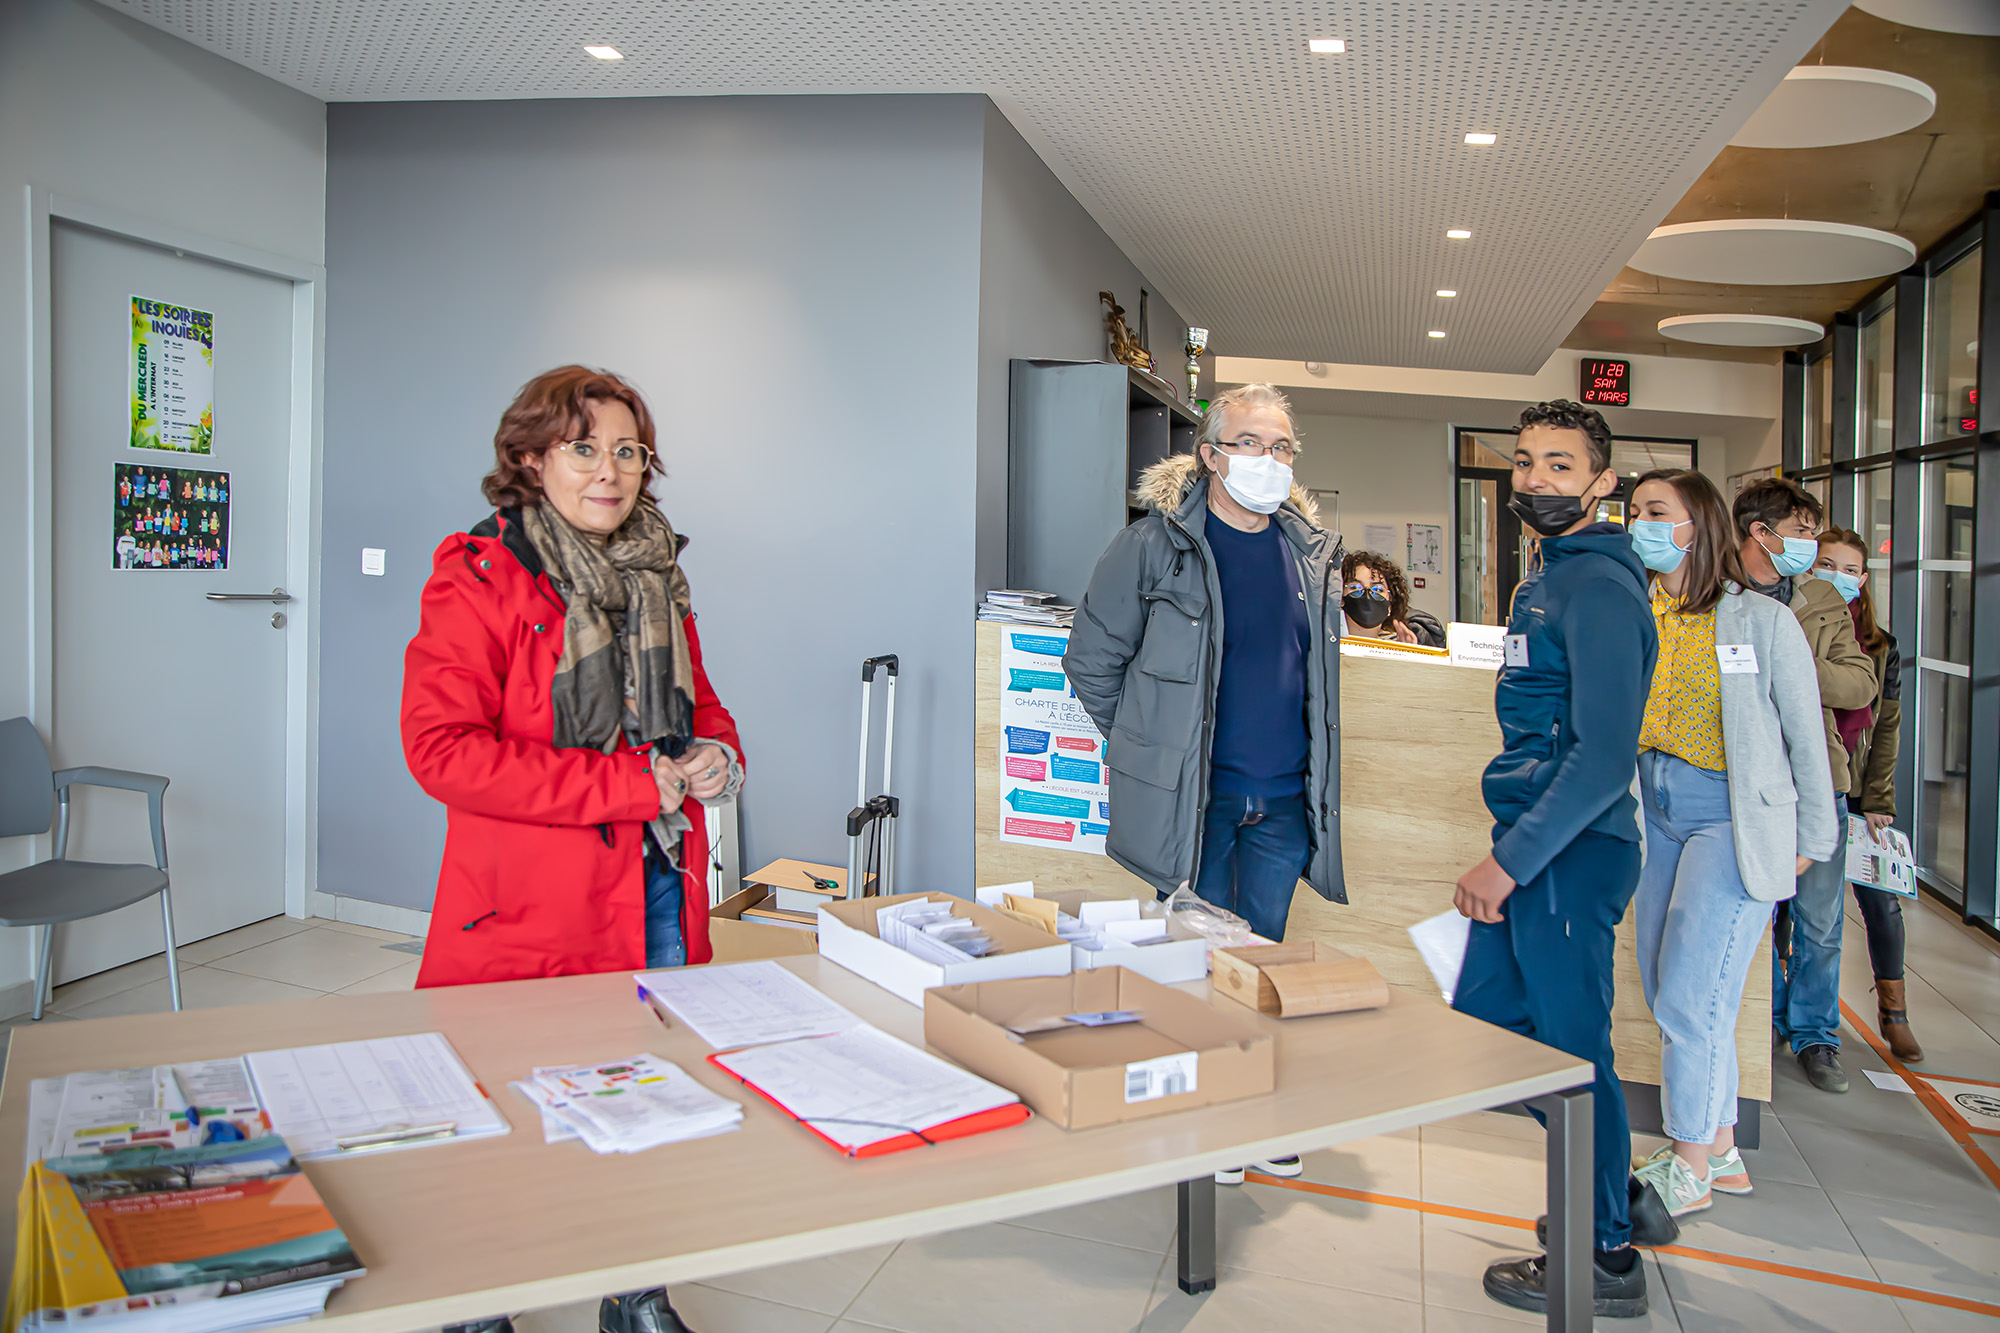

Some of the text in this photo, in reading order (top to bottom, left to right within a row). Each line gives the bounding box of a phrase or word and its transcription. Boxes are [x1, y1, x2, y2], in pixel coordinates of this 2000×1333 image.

[138, 300, 160, 317] LES
[137, 343, 148, 420] DU MERCREDI
[1593, 377, 1617, 389] SAM
[1585, 390, 1629, 403] 12 MARS
[1015, 698, 1058, 710] CHARTE
[1061, 702, 1076, 713] DE
[1060, 712, 1094, 724] L'ÉCOL
